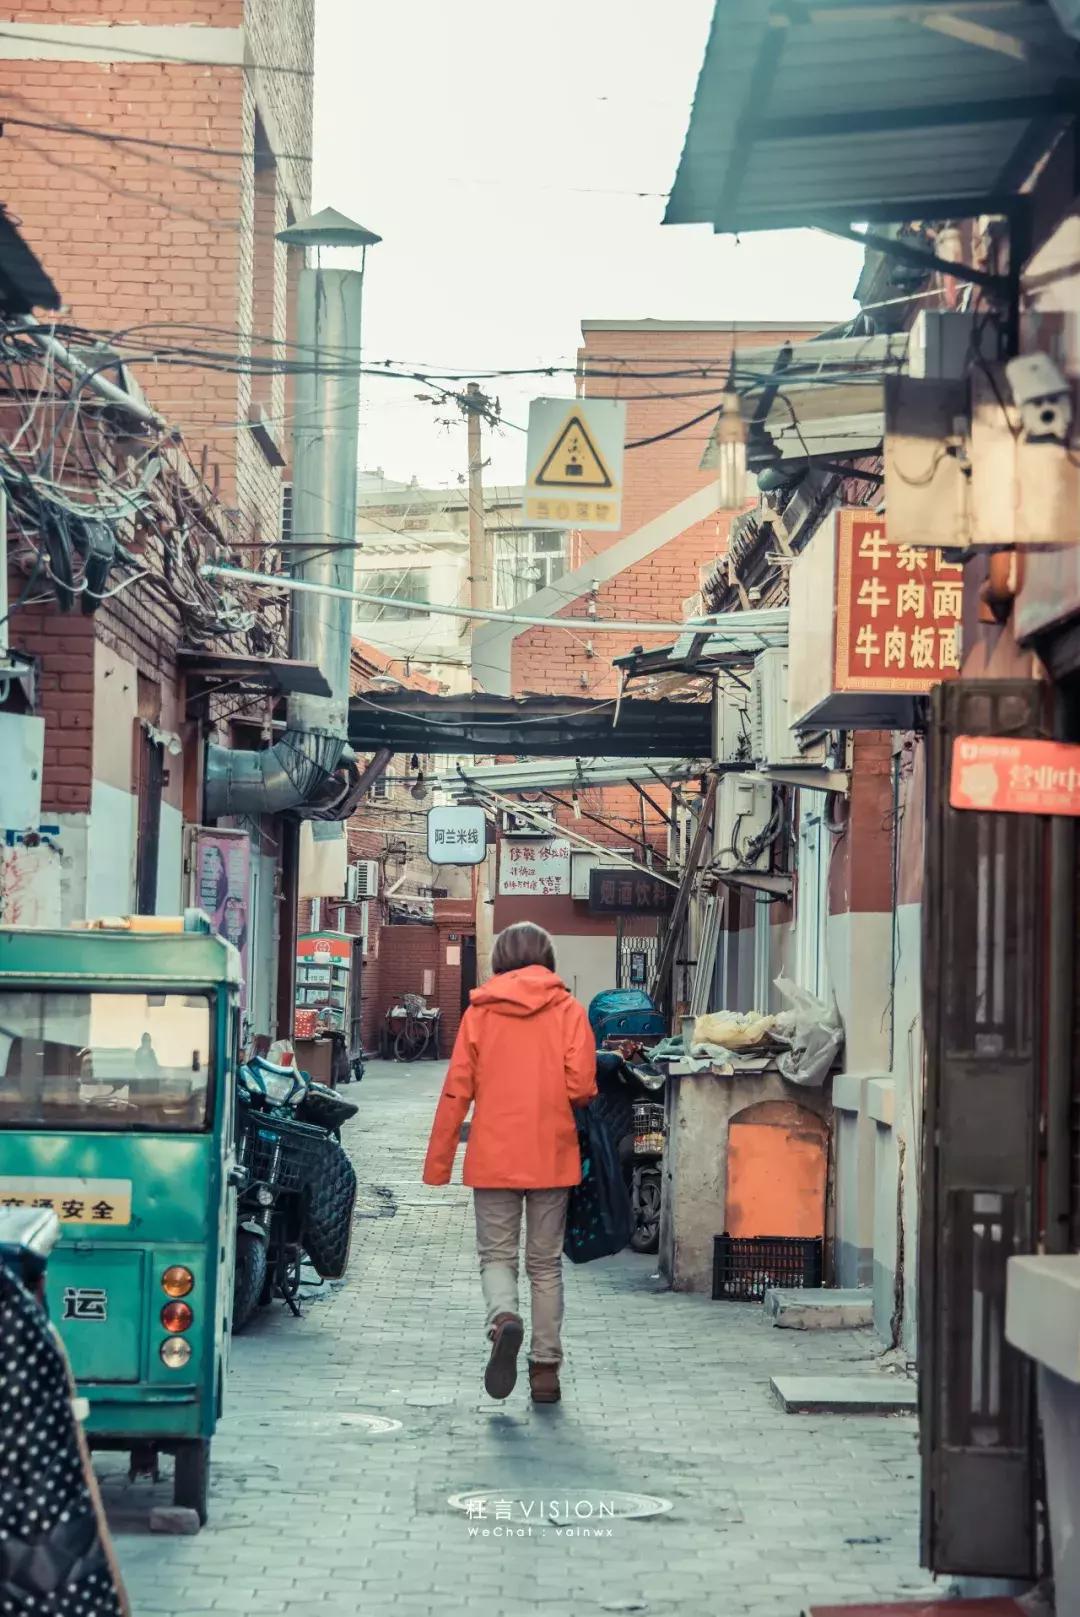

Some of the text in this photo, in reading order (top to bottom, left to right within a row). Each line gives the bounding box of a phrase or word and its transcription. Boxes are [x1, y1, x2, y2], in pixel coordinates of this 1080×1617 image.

[857, 577, 964, 619] 牛肉面
[855, 624, 961, 670] 牛肉板面
[434, 829, 479, 845] 阿兰米线
[599, 880, 667, 905] 烟酒饮料
[63, 1287, 107, 1321] 运
